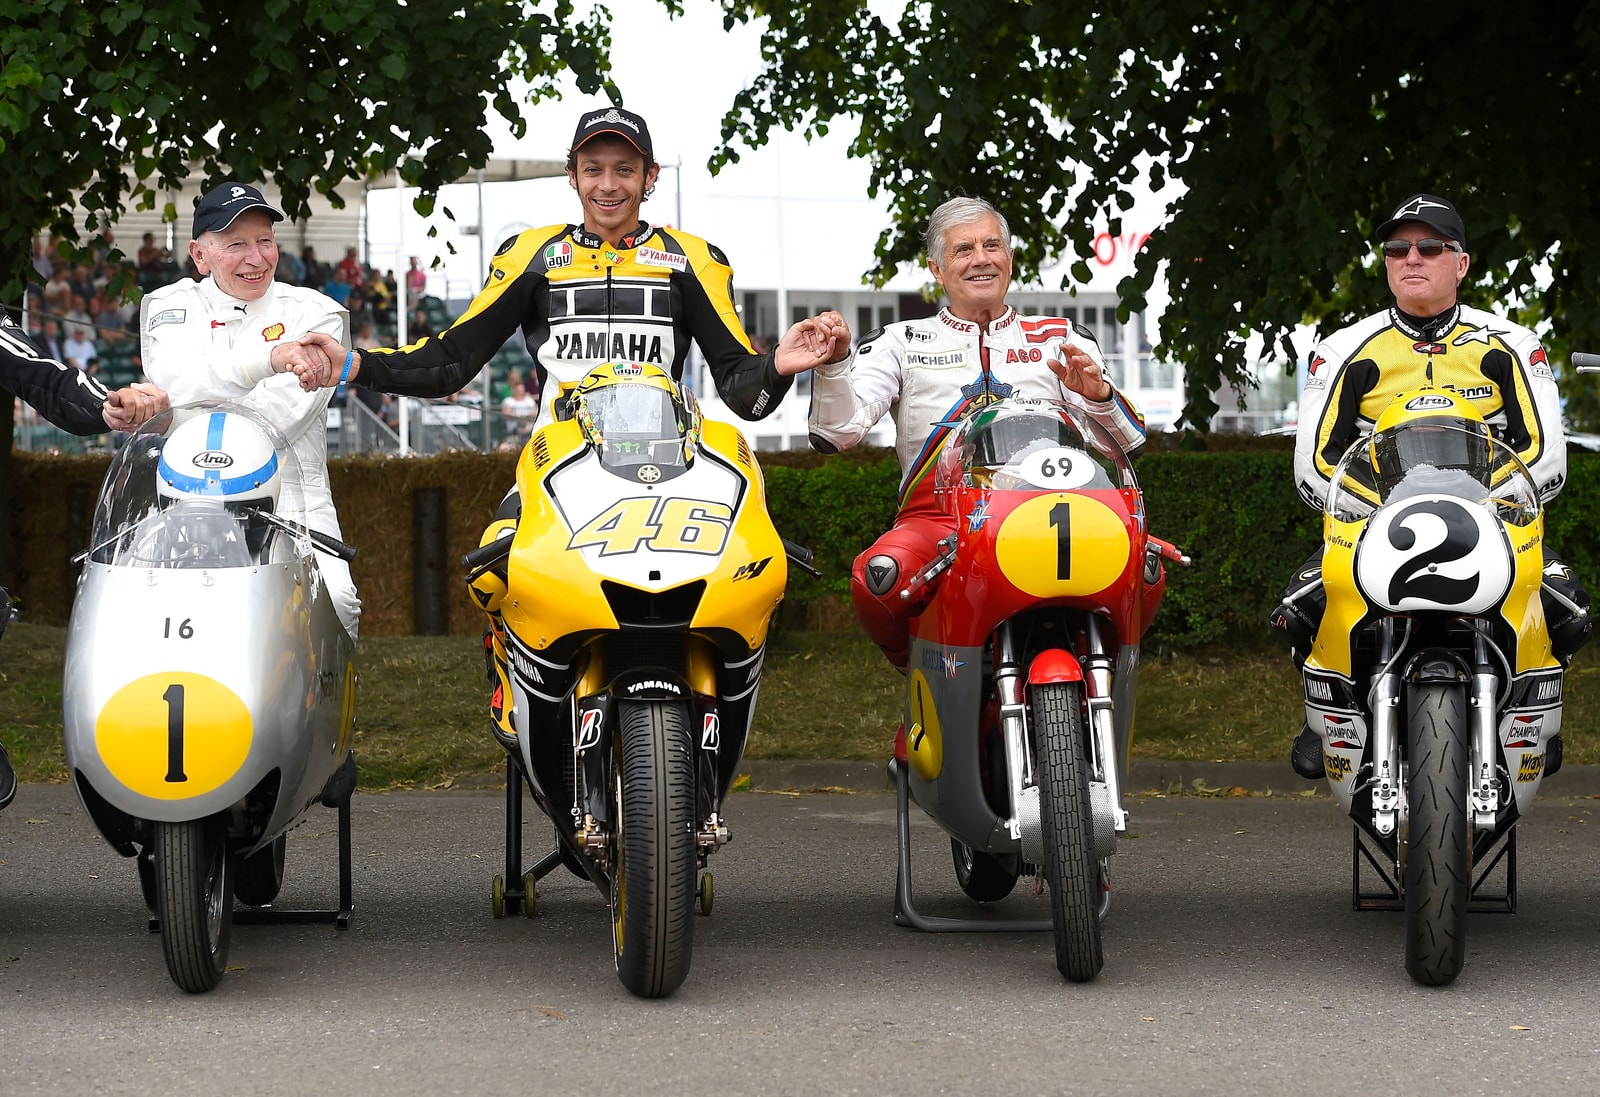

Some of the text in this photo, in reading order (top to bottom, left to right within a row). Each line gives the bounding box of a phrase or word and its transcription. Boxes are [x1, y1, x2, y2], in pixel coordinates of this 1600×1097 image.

[584, 238, 599, 248] Bag
[548, 255, 570, 267] agv
[649, 250, 685, 265] YAMAHA
[915, 333, 931, 341] api
[555, 332, 662, 363] YAMAHA
[907, 353, 963, 365] MICHELIN
[1006, 348, 1042, 363] AGO
[1409, 397, 1447, 409] Arai
[195, 453, 230, 464] Arai
[532, 431, 550, 471] YAMAHA
[1041, 457, 1073, 477] 69
[566, 496, 733, 557] 46
[1049, 503, 1071, 580] 1
[1387, 500, 1480, 605] 2
[164, 617, 194, 639] 16
[627, 681, 681, 694] YAMAHA
[1307, 679, 1333, 701] YAMAHA
[163, 684, 188, 782] 1
[1326, 726, 1358, 740] CHAMPION
[1510, 726, 1540, 738] CHAMPION
